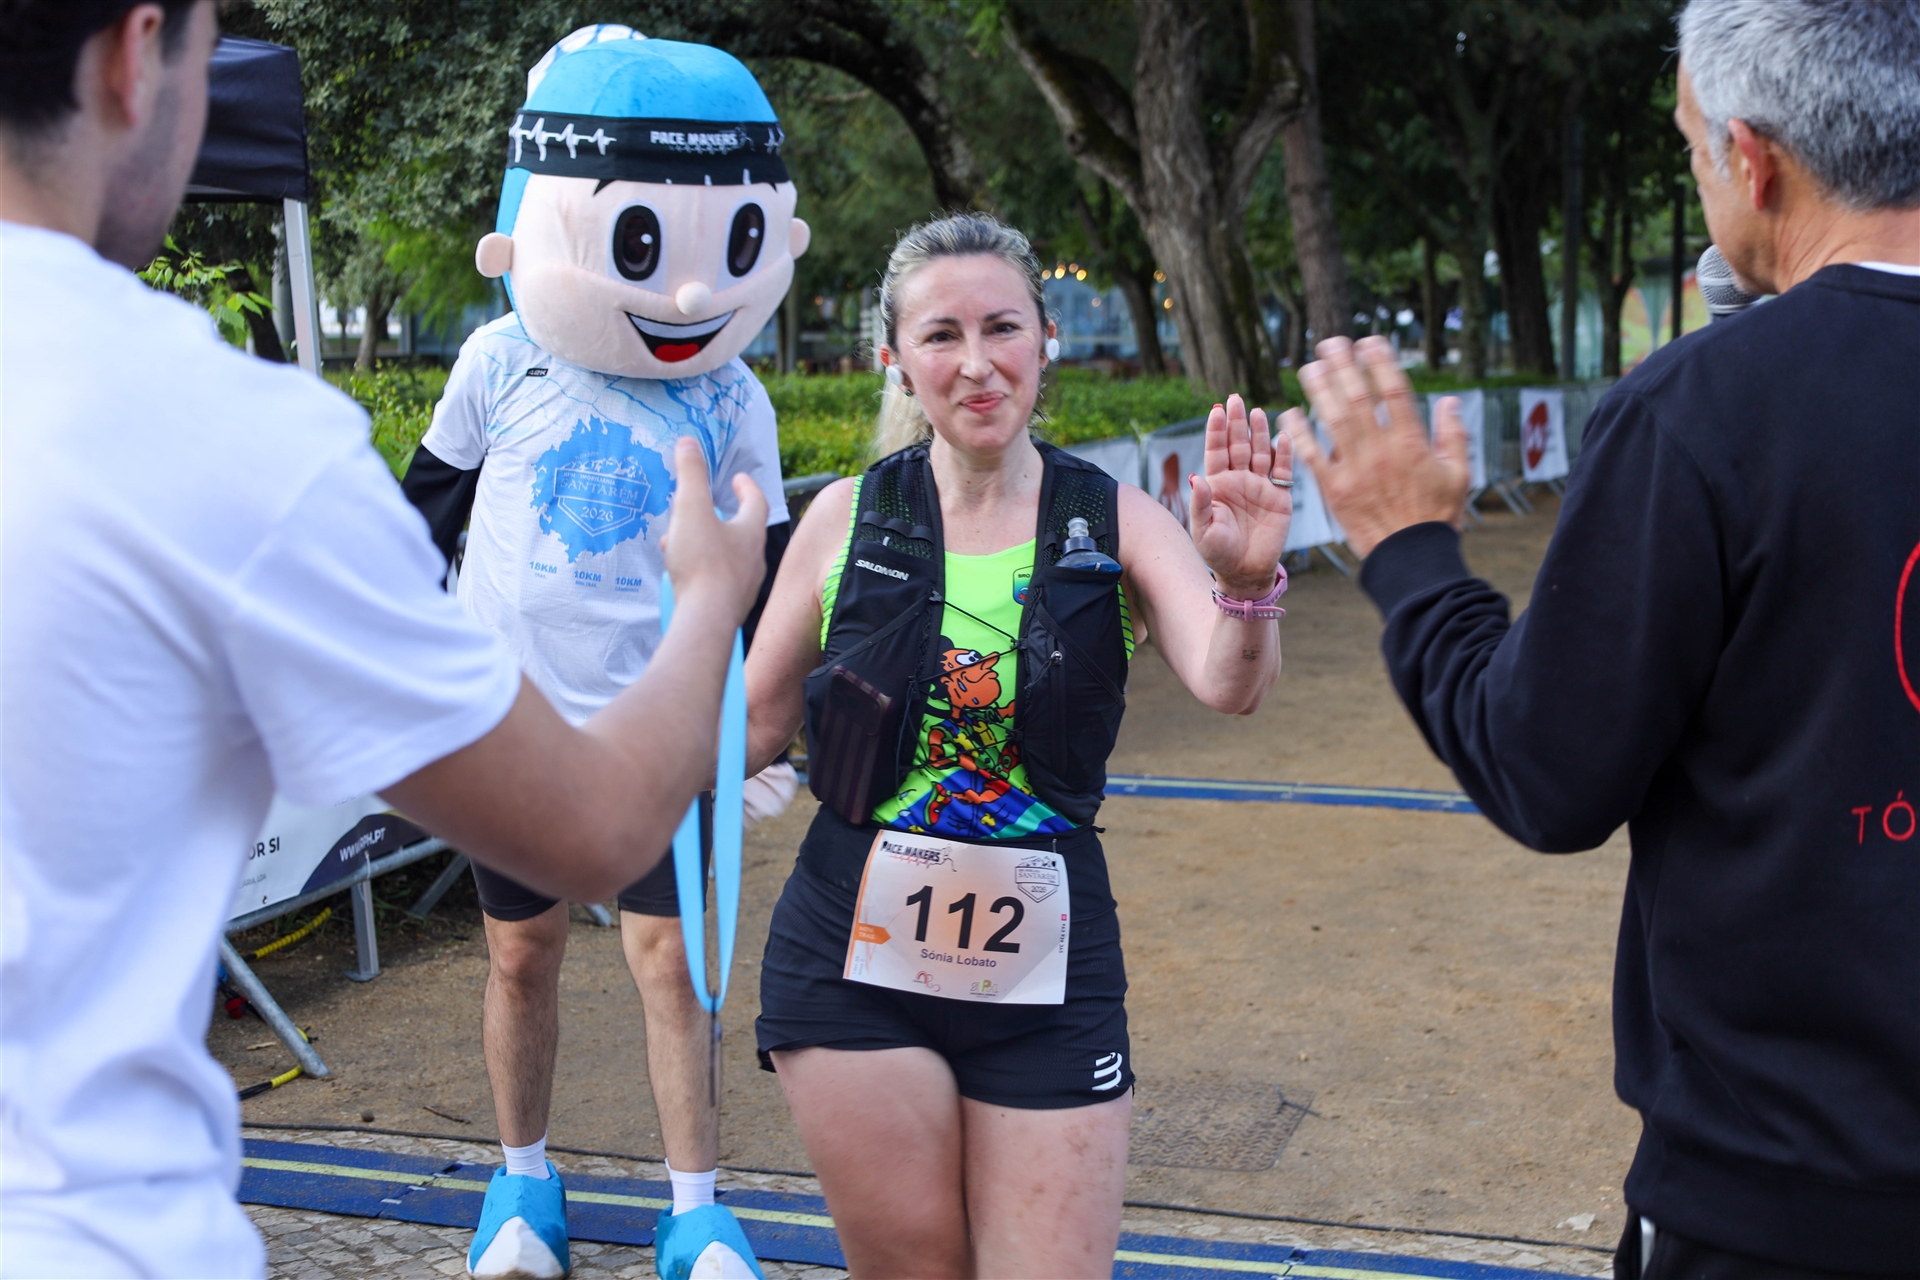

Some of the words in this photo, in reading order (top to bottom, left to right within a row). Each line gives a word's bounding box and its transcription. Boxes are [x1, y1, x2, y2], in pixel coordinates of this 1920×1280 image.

[650, 131, 685, 145] PACE
[687, 133, 739, 146] MAKERS
[560, 478, 639, 500] SANTARÉM
[581, 506, 614, 523] 2026
[529, 561, 558, 574] 18KM
[573, 570, 602, 582] 10KM
[854, 559, 910, 581] SALOMON
[615, 577, 642, 587] 10KM
[1851, 789, 1917, 846] TÓ
[905, 885, 1026, 954] 112
[919, 948, 953, 964] Sónia
[956, 954, 998, 968] Lobato
